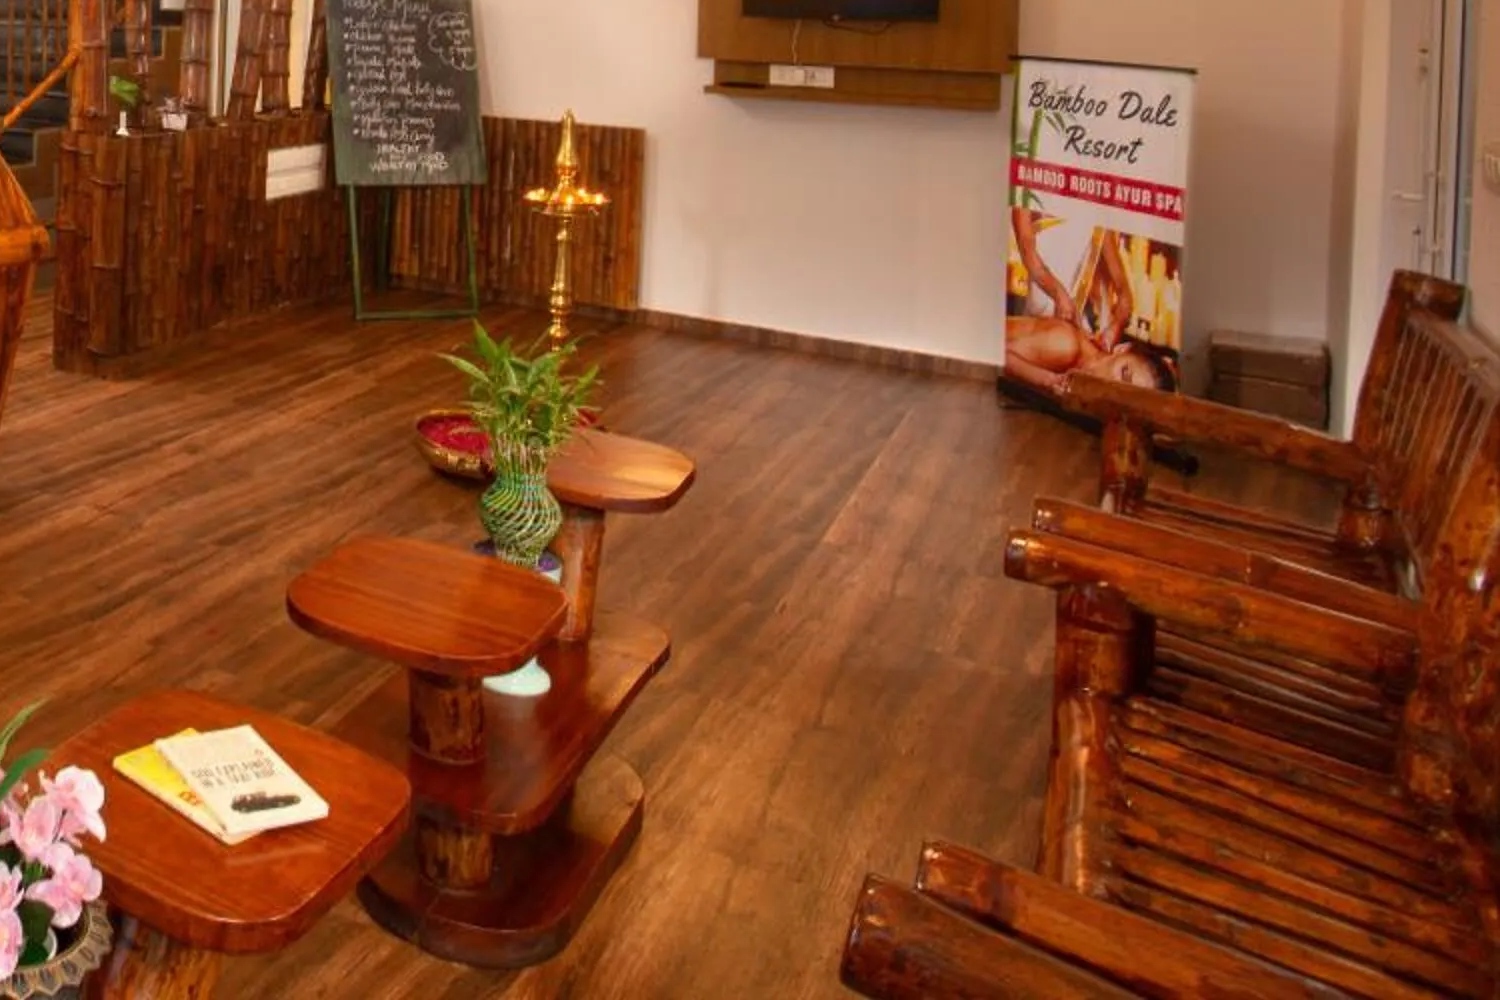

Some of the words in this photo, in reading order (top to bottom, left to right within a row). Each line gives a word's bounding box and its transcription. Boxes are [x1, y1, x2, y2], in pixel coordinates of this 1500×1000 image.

[1029, 80, 1108, 117] Bamboo
[1118, 90, 1178, 127] Dale
[1063, 125, 1144, 164] Resort
[1017, 164, 1066, 189] BAMBOO
[1069, 174, 1112, 199] ROOTS
[1114, 182, 1153, 207] AYUR
[1155, 191, 1184, 213] SPA
